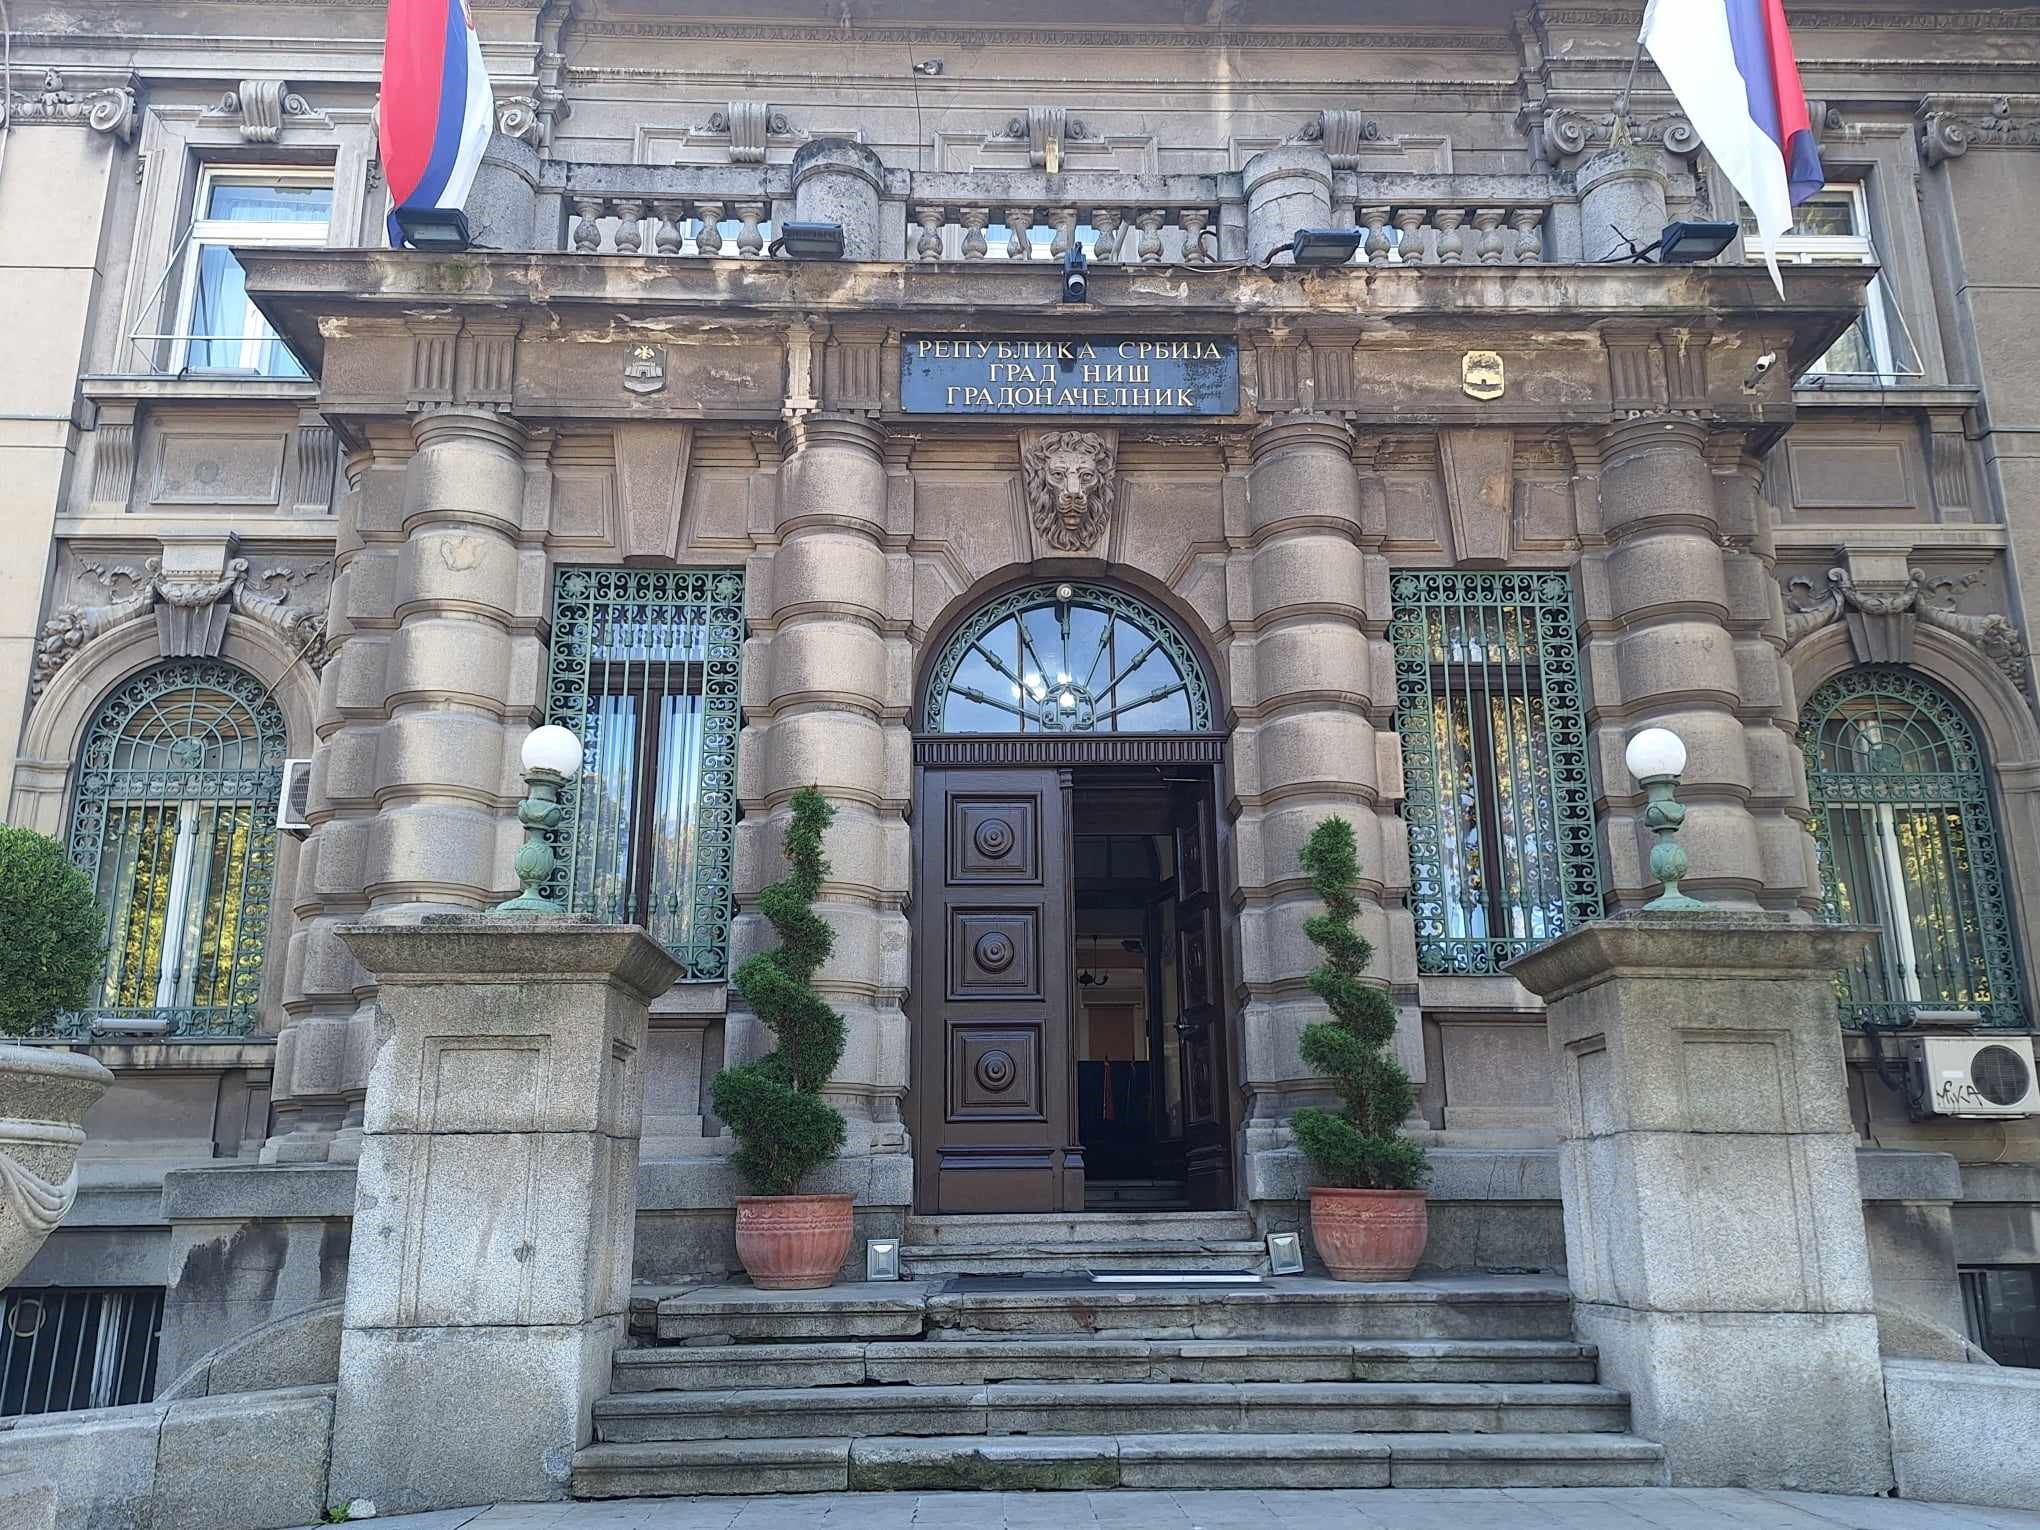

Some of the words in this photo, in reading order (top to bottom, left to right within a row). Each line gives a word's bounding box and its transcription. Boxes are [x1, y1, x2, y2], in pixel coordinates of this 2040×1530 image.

[918, 340, 1097, 360] РЕПУБЛИКА
[1118, 341, 1222, 360] СРБИЈА
[988, 365, 1058, 384] ГРАД
[1083, 365, 1151, 383] НИШ
[947, 387, 1196, 408] ГРАДОНАЧЕЛНИК
